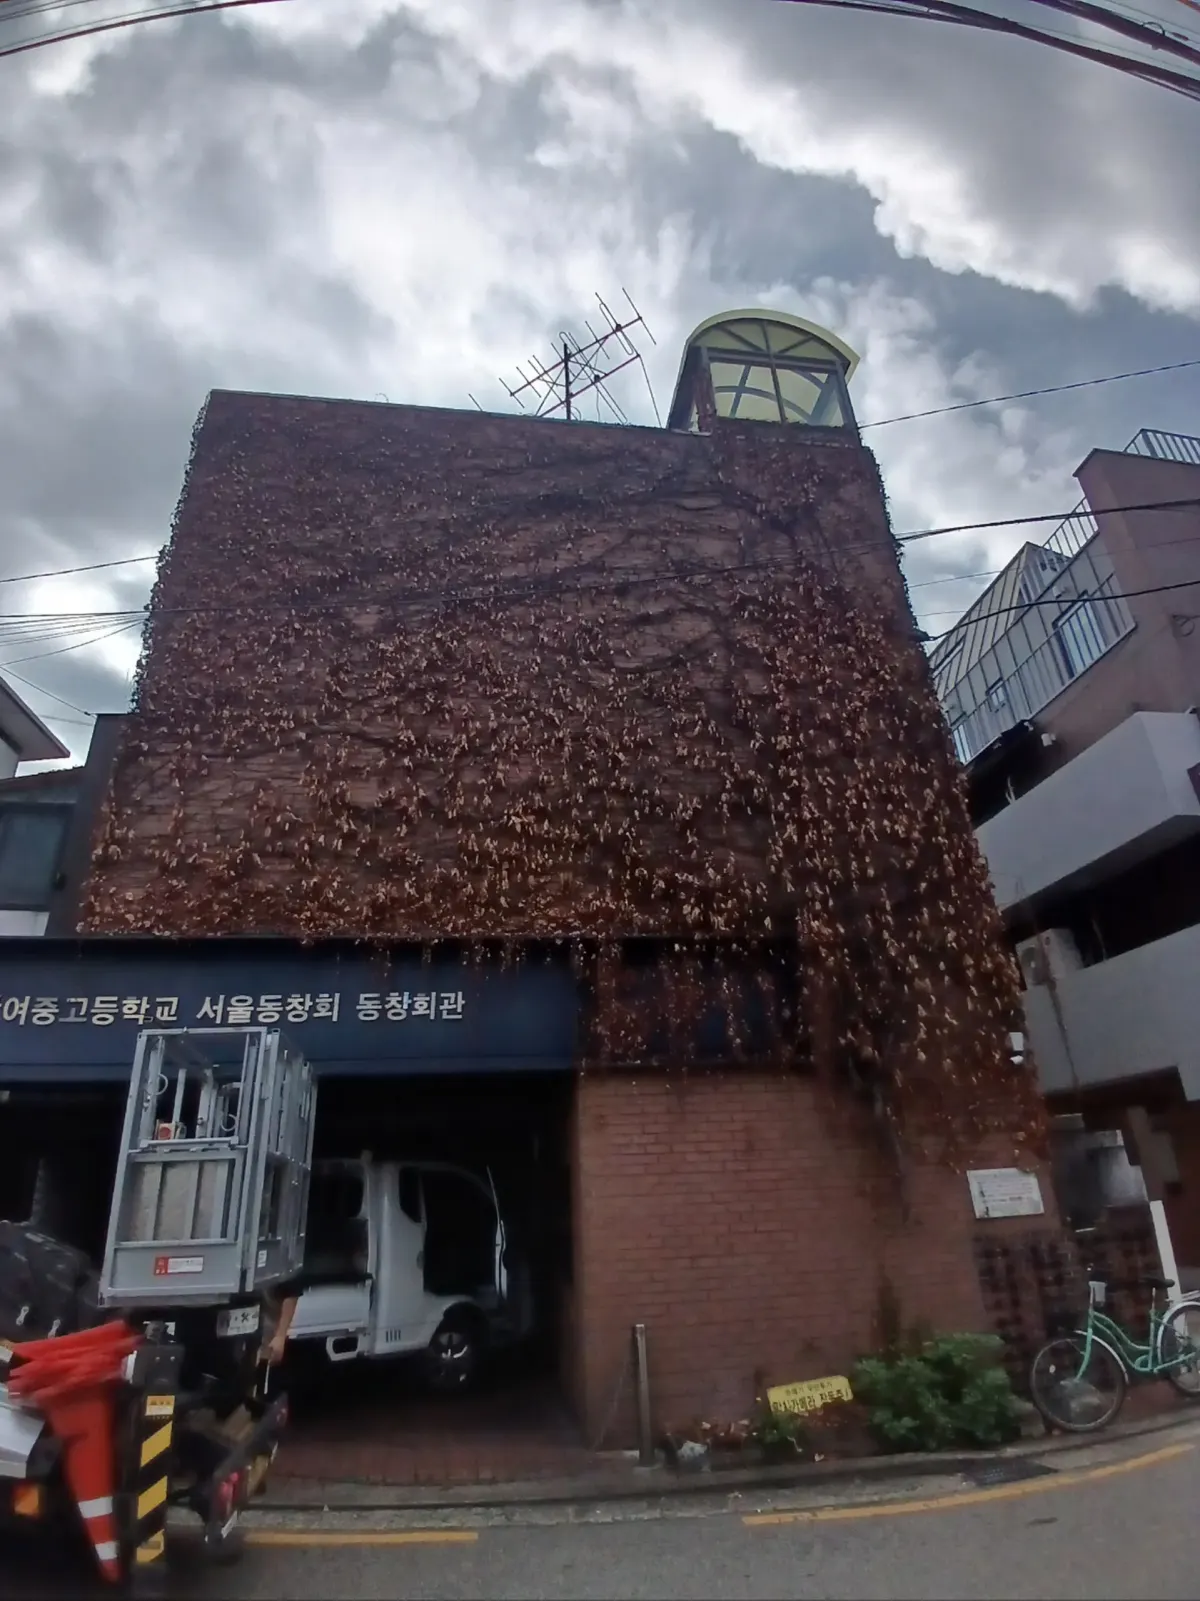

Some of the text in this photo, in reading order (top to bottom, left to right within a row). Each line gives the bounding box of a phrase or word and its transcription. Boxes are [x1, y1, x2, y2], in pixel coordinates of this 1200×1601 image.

[0, 991, 466, 1026] 여중고등학교 서울동창회 동창회관
